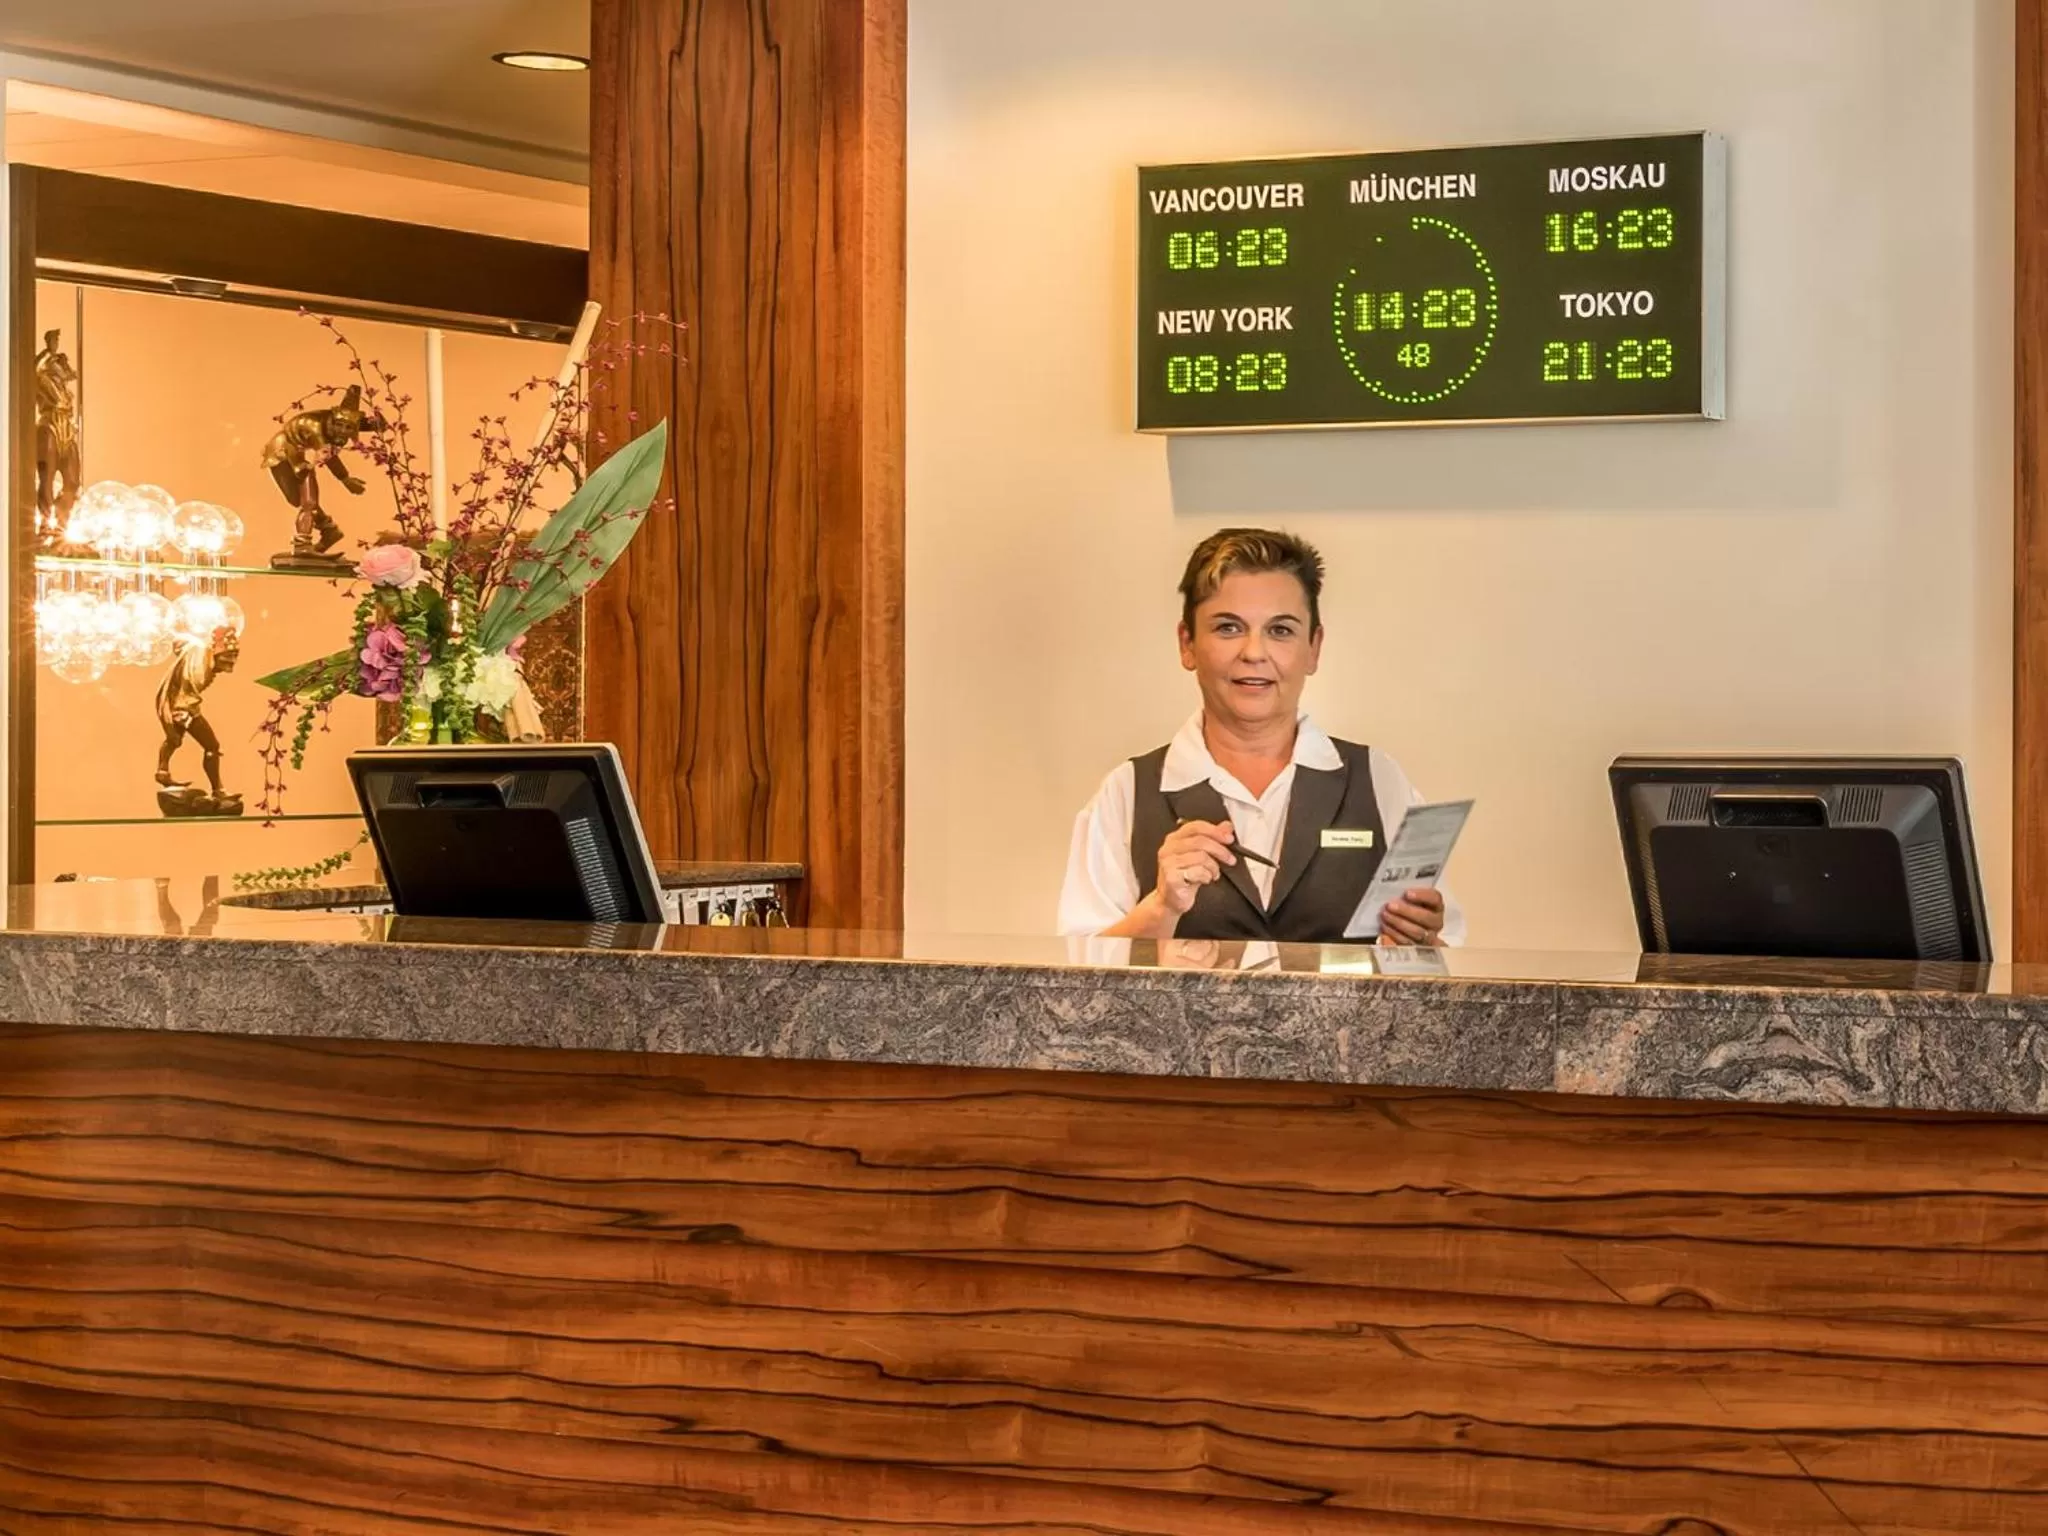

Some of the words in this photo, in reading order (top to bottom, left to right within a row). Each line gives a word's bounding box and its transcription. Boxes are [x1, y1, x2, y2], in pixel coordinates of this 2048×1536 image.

[1349, 172, 1477, 204] MÜNCHEN
[1548, 162, 1666, 194] MOSKAU
[1149, 183, 1305, 214] VANCOUVER
[1546, 207, 1673, 253] 16:23
[1168, 227, 1288, 270] 06:23
[1353, 288, 1477, 332] 14:23
[1559, 290, 1655, 318] TOKYO
[1157, 309, 1216, 335] NEW
[1220, 306, 1294, 332] YORK
[1396, 342, 1431, 368] 48
[1543, 338, 1673, 382] 21:23
[1167, 352, 1287, 394] 08:23
